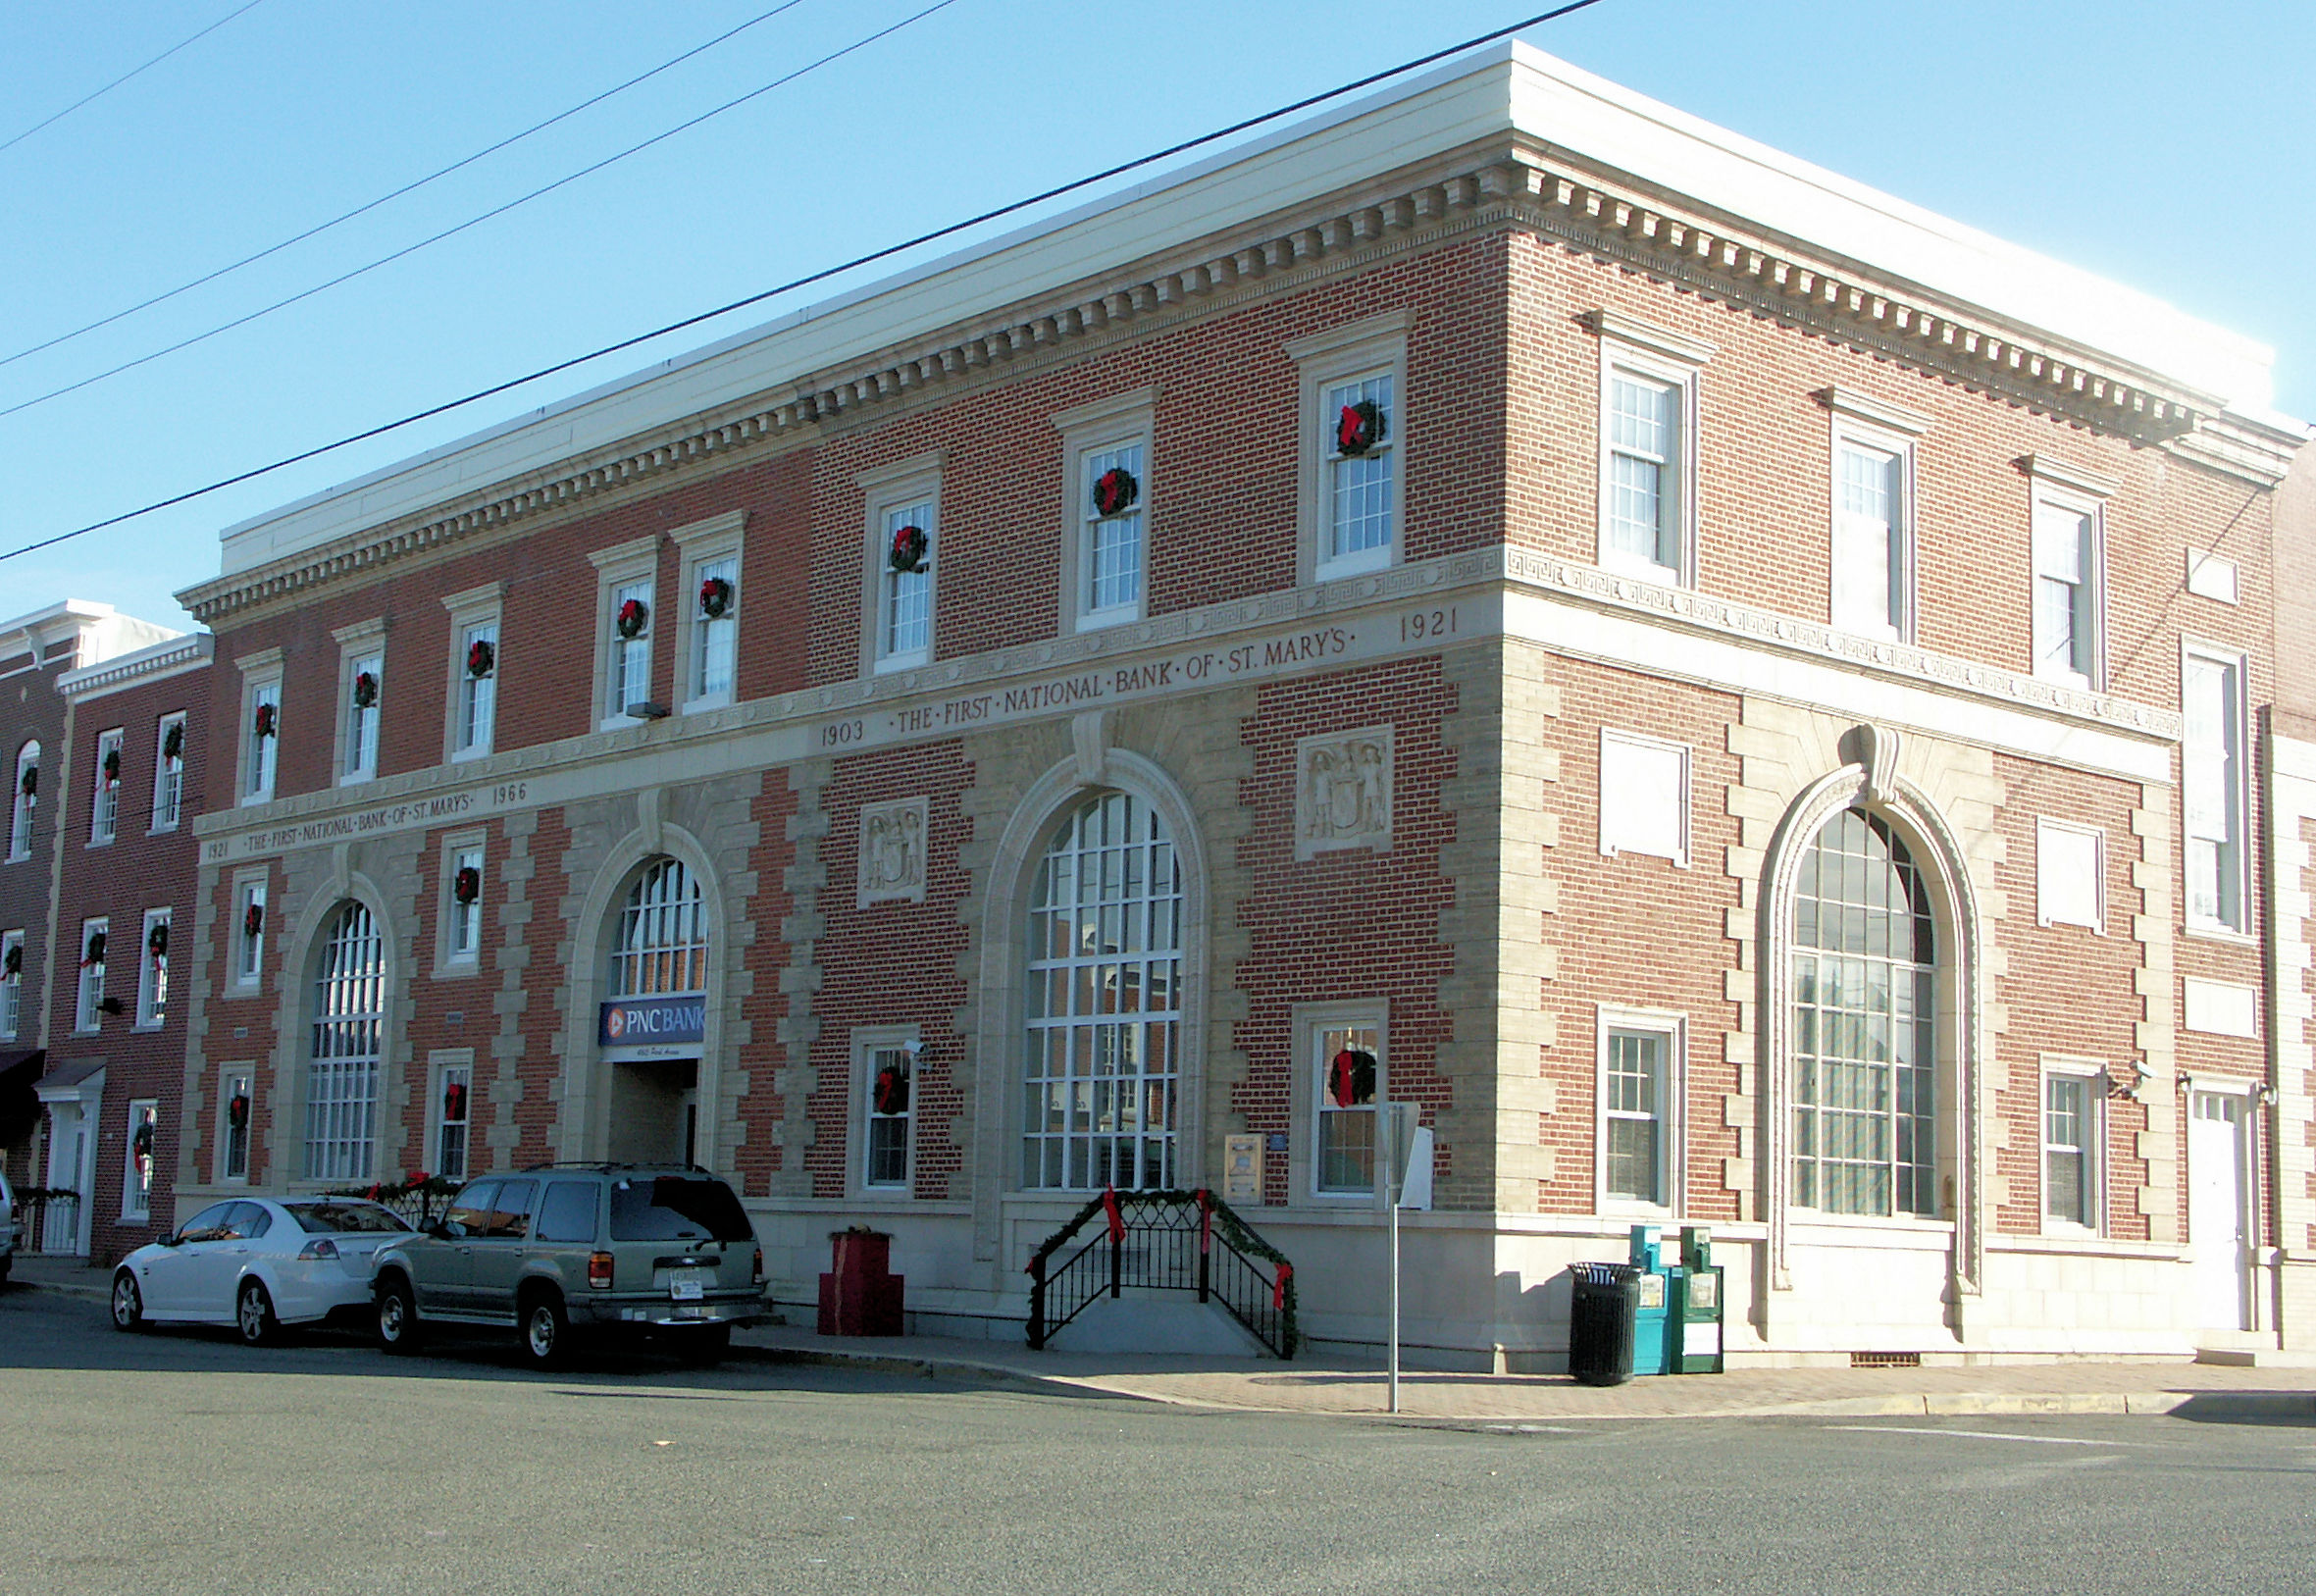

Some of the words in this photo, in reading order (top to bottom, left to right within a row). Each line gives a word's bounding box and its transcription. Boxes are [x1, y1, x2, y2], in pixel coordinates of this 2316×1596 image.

[821, 720, 863, 747] 1903
[898, 707, 933, 733] THE
[944, 695, 993, 725] FIRST
[1004, 674, 1104, 713] NATIONAL
[1115, 660, 1173, 694] BANK
[1186, 654, 1214, 679] OF
[1228, 645, 1258, 673] ST.
[1263, 628, 1346, 667] MARY'S
[1401, 606, 1457, 643] 1921
[208, 841, 229, 859] 1921
[248, 834, 266, 851] THE
[272, 828, 298, 848] FIRST
[302, 815, 353, 842] NATIONAL
[358, 810, 387, 832] BANK
[392, 806, 408, 825] OF
[430, 794, 470, 817] MARY'S
[492, 783, 527, 805] 1966
[626, 1008, 661, 1034] PNC
